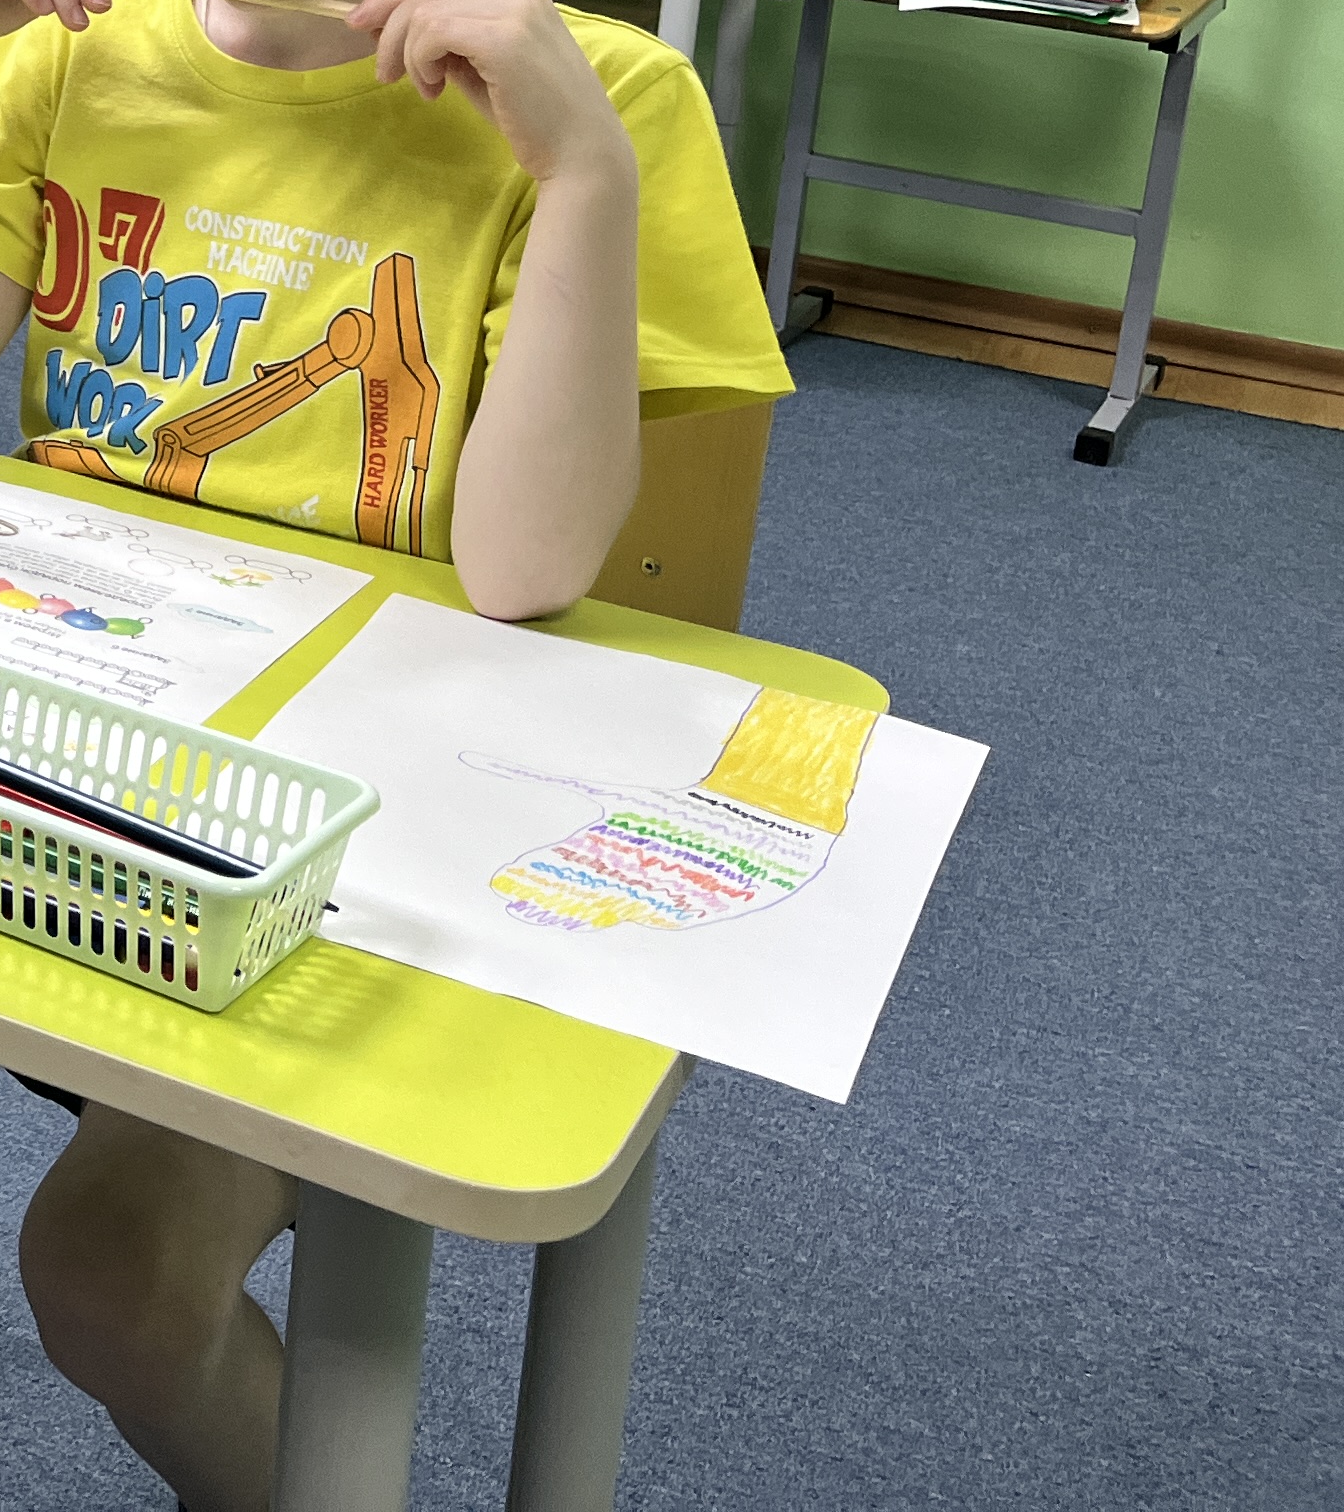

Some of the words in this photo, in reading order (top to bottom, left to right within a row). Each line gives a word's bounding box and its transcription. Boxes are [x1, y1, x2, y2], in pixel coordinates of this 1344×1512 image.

[184, 205, 369, 266] CONSTRUCTION
[206, 241, 314, 291] MACHINE
[45, 350, 164, 455] WORK
[368, 378, 389, 449] WORKER
[363, 452, 387, 508] HARD
